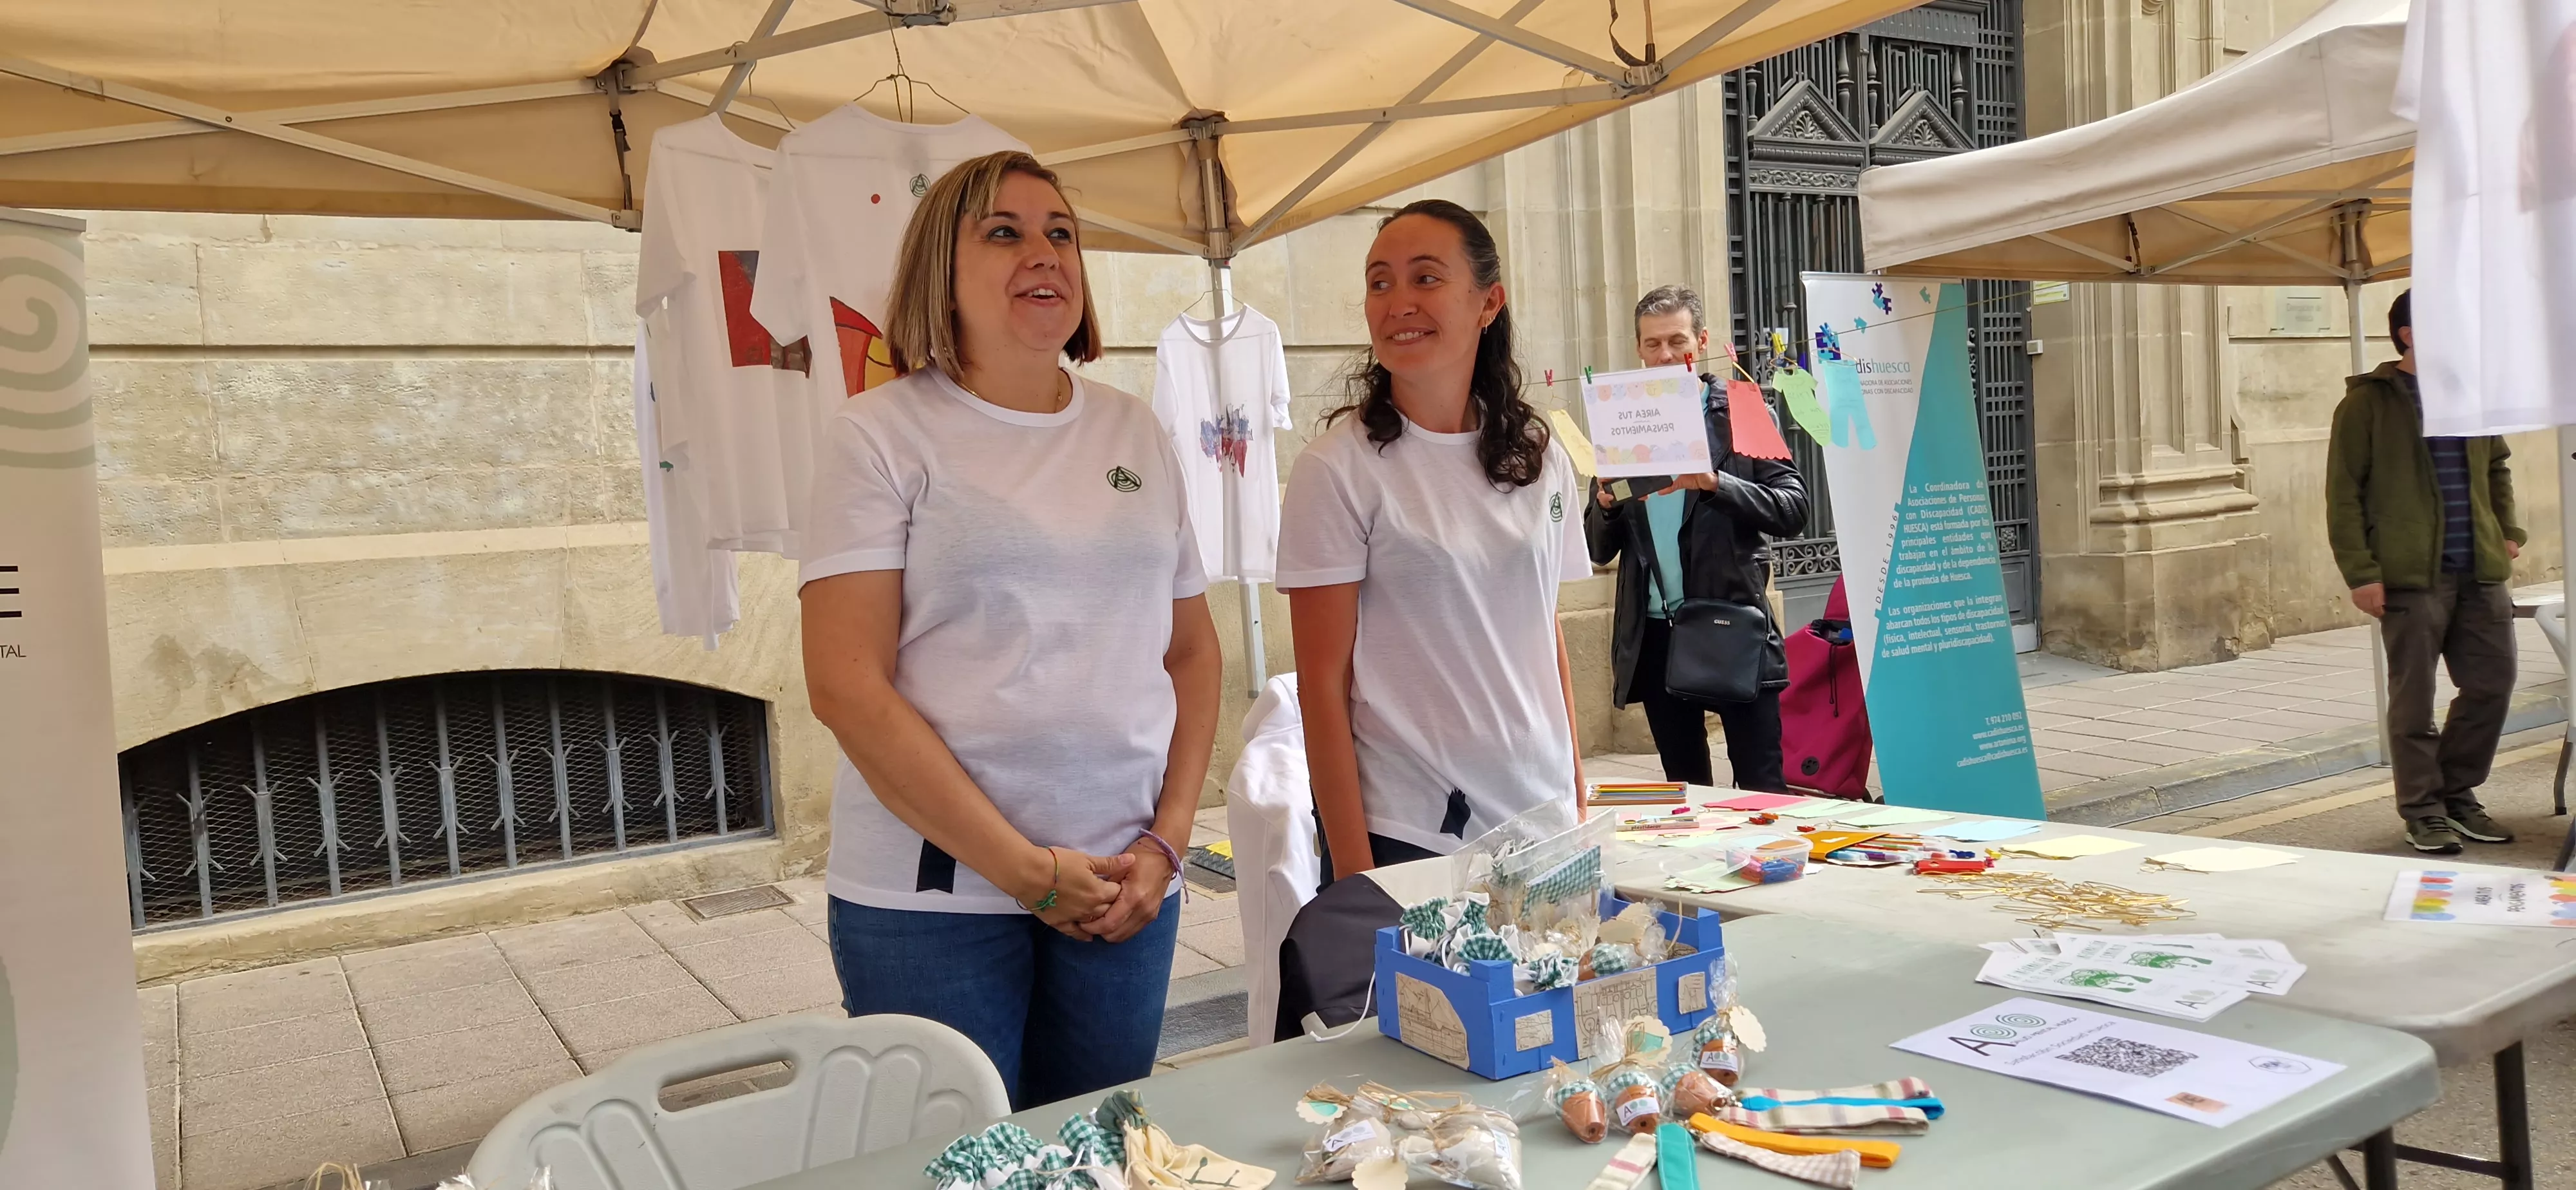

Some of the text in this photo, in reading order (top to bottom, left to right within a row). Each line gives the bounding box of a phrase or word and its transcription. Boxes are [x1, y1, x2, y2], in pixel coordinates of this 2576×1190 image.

[1909, 480, 1984, 493] La Coordinadora de
[1908, 494, 1985, 507] Asociaciones de Personas
[1920, 507, 1963, 519] Discapacidad
[1967, 505, 1987, 516] (CADIS
[1904, 516, 1990, 533] HUESCA) está formada por las
[1901, 532, 1992, 549] principales entidades que
[1875, 515, 1898, 604] DESDE 1996
[1899, 549, 1926, 562] trabajan
[1942, 547, 1947, 556] el
[1951, 545, 1973, 555] ámbito
[1977, 543, 1985, 552] de
[1988, 542, 1994, 551] la
[1896, 556, 1996, 574] discapacidad y de la dependencia
[1893, 571, 1973, 589] de la provincia de Huesca.
[1888, 594, 2002, 616] Las organizaciones que la integran
[1886, 605, 2004, 630] abarcan todos los tipos de discapacidad
[1908, 627, 1942, 640] intelectual,
[1944, 623, 1974, 636] sensorial,
[1975, 619, 2007, 631] trastornos
[1882, 648, 1889, 658] de
[1891, 645, 1909, 657] salud
[1911, 642, 1933, 654] mental
[1933, 644, 1940, 653] y
[1991, 715, 2001, 724] 974
[2002, 713, 2012, 722] 210
